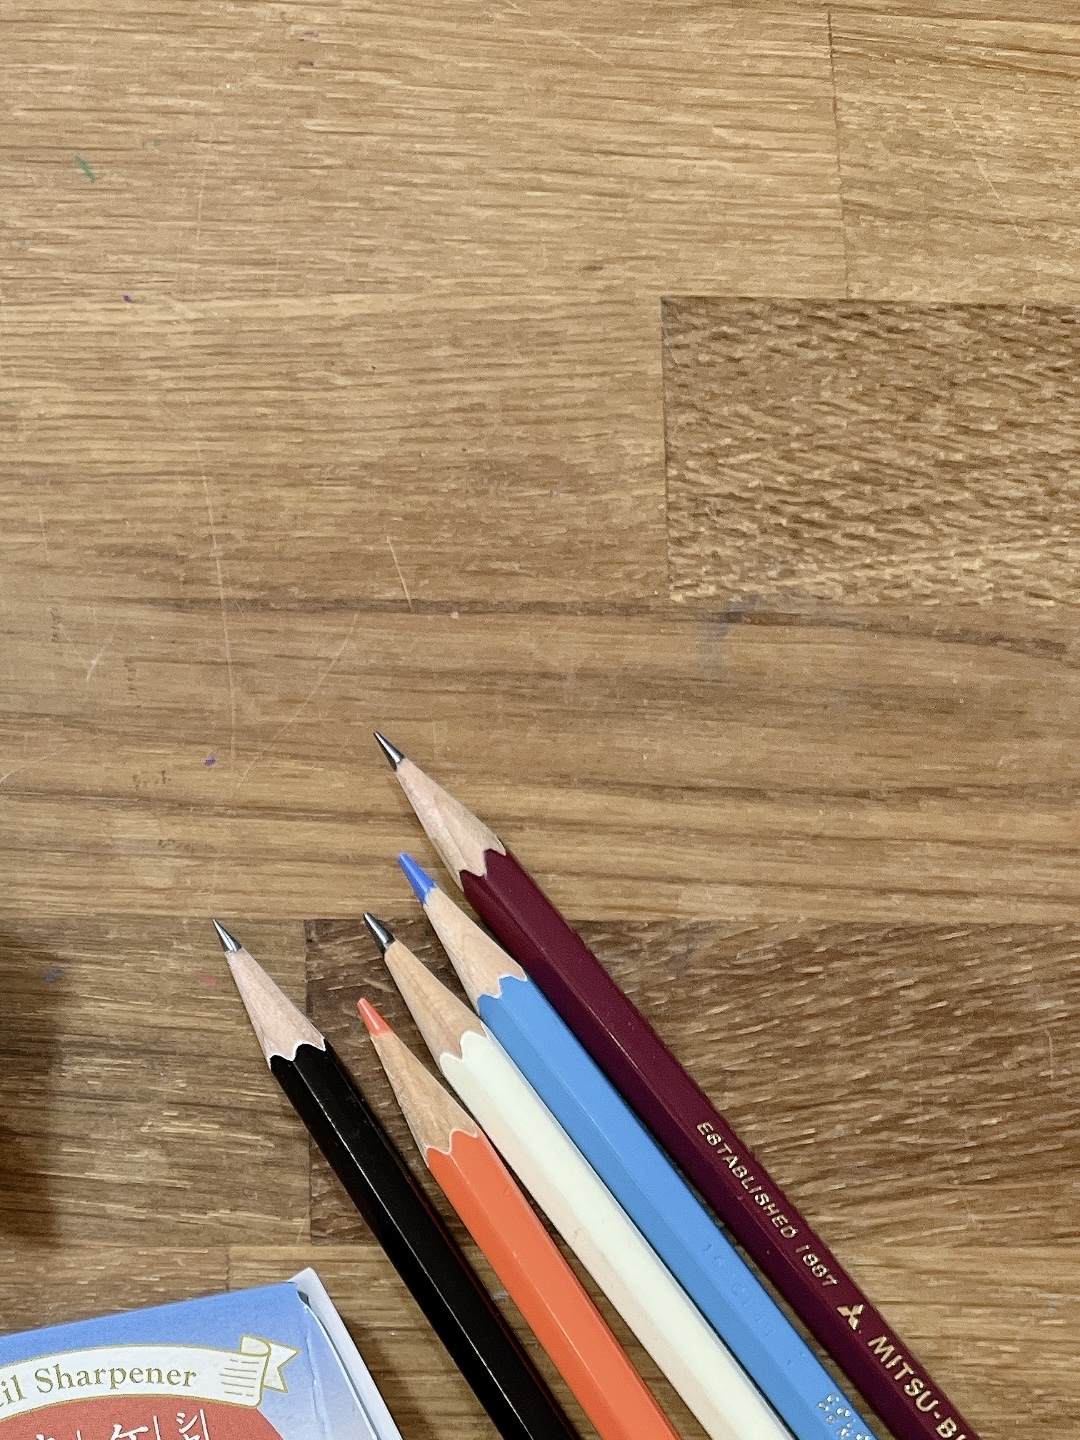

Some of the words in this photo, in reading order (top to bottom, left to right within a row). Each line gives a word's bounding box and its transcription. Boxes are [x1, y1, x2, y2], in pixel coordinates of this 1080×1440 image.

[695, 1120, 800, 1240] ESTABLISHED
[795, 1243, 839, 1287] 1887
[33, 1363, 197, 1395] Sharpener
